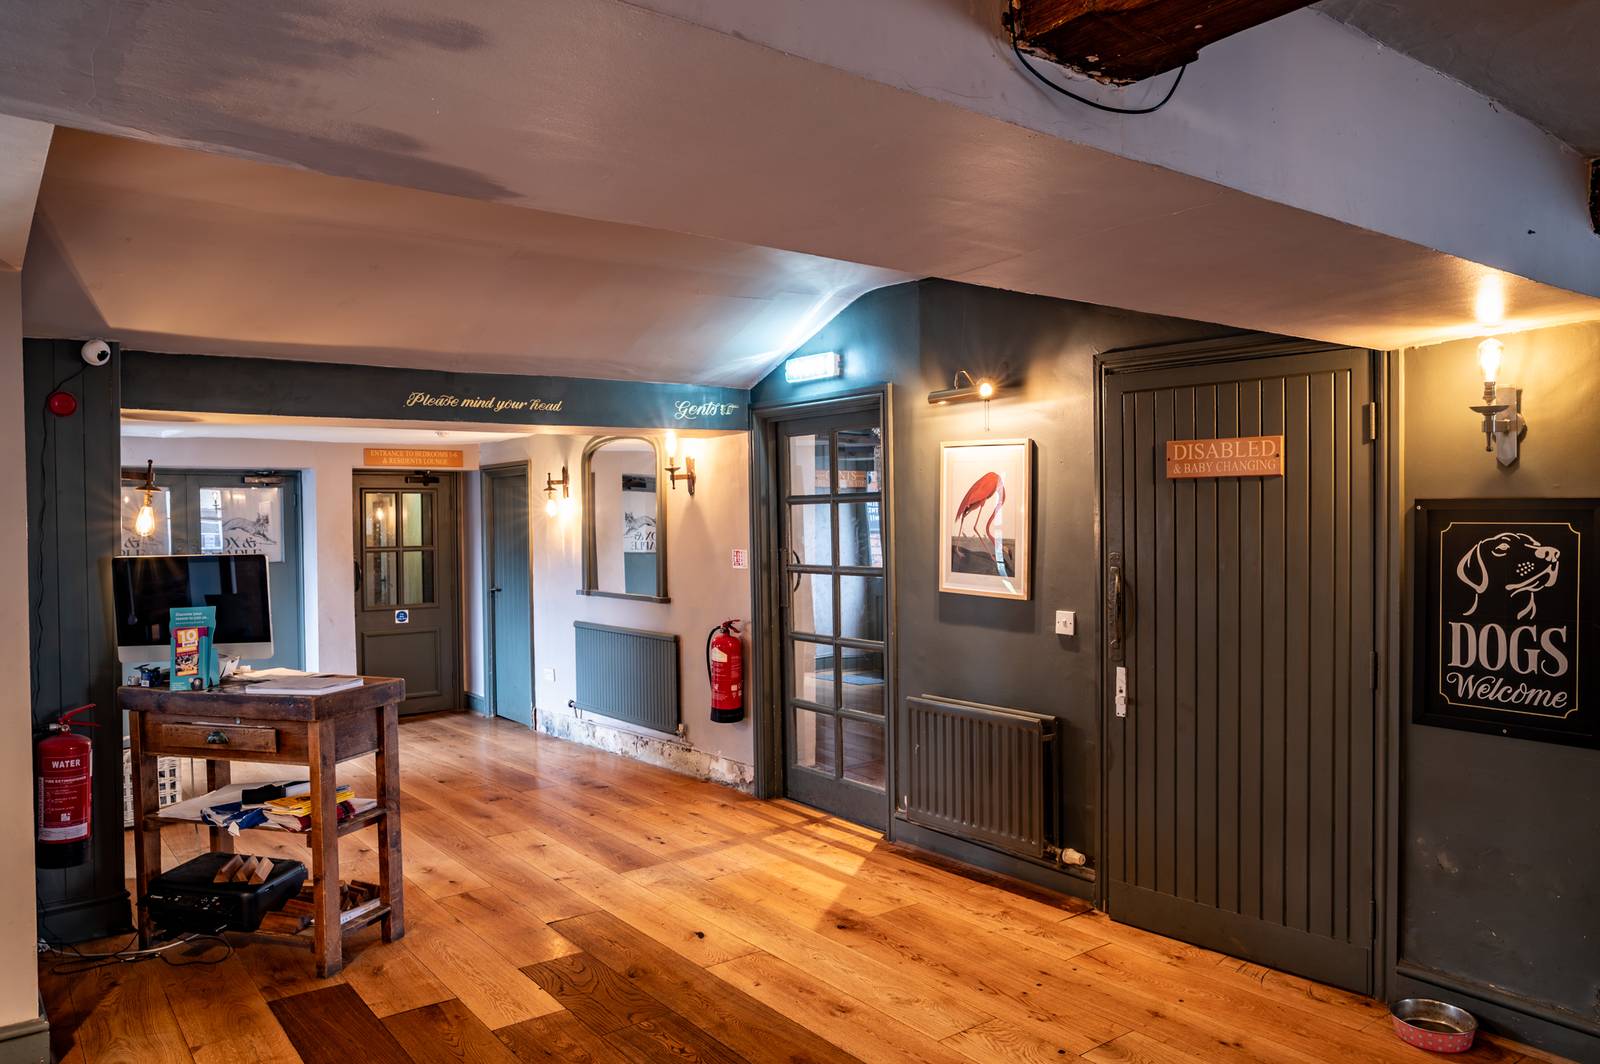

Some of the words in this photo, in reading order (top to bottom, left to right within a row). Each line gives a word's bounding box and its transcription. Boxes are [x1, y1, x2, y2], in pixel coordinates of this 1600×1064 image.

[406, 391, 459, 407] Please
[461, 396, 496, 409] mind
[494, 399, 528, 413] your
[529, 398, 563, 412] head
[674, 400, 720, 420] Gents
[370, 449, 401, 457] ENTRANCE
[415, 450, 448, 458] BEDROOMS
[1174, 440, 1276, 460] DISABLED
[1173, 463, 1181, 474] &
[1184, 461, 1214, 474] BABY
[1215, 460, 1276, 472] CHANGING
[242, 537, 257, 548] &
[178, 629, 197, 642] 10
[1448, 621, 1568, 677] DOGS
[1446, 672, 1568, 709] Welcome
[51, 758, 81, 769] WATER
